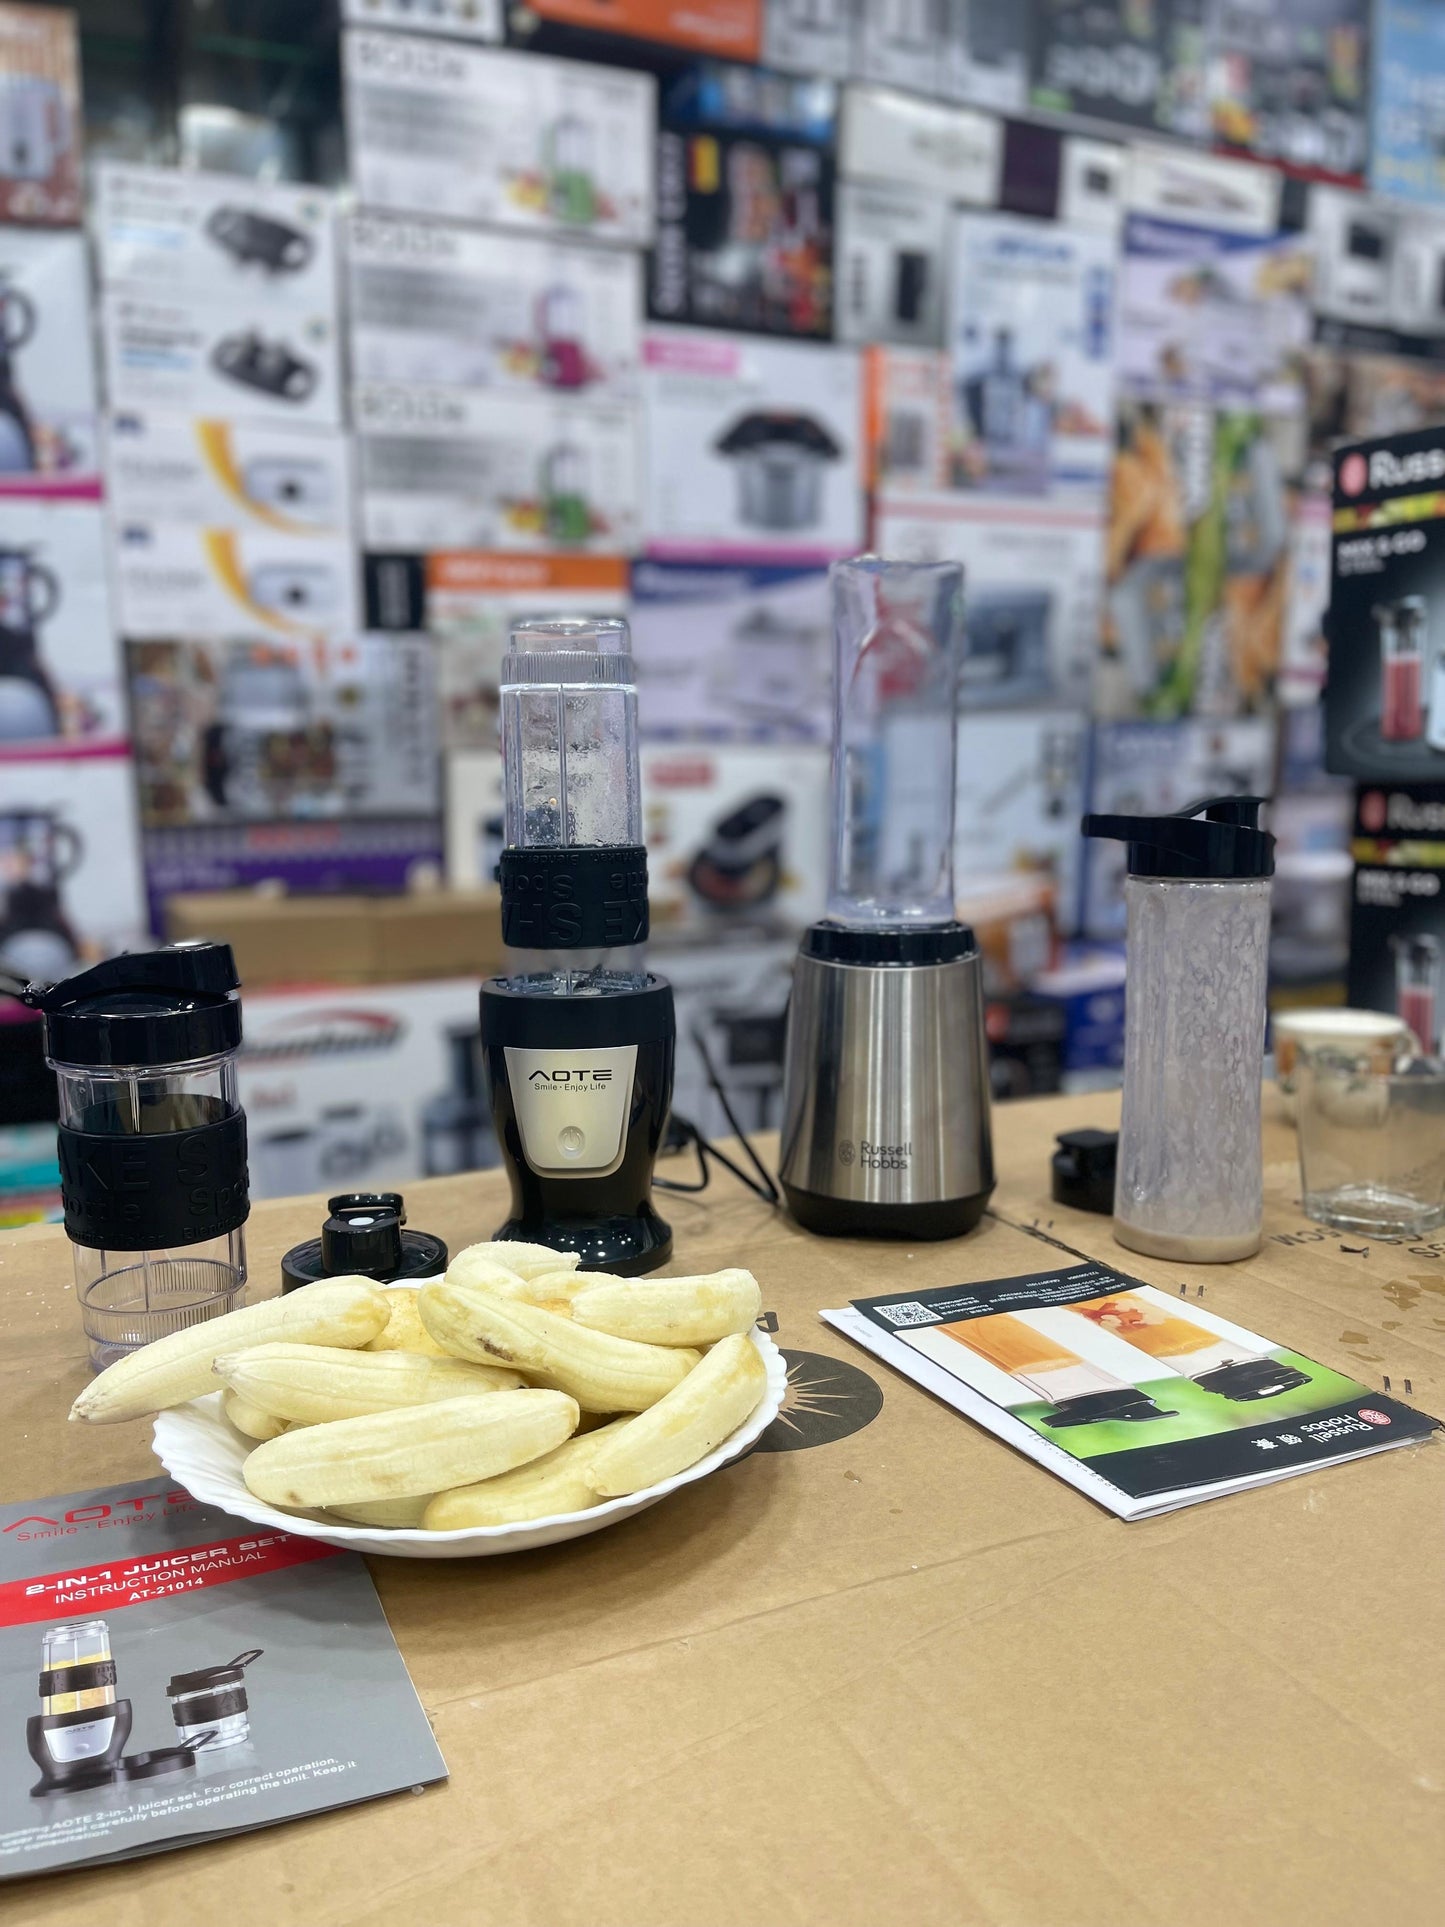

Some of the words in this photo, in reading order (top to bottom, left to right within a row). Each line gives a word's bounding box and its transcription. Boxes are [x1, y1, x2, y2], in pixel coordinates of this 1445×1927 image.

[528, 1069, 613, 1082] AOTE
[534, 1082, 558, 1091] Smile
[564, 1083, 588, 1093] Enjoy
[590, 1082, 606, 1091] Life
[861, 1140, 913, 1156] Russell
[861, 1155, 908, 1169] Hobbs
[1300, 1414, 1359, 1433] Hobbs
[1307, 1421, 1374, 1444] Russell
[17, 1525, 78, 1542] Smile
[97, 1510, 156, 1530] Enjoy
[26, 1570, 111, 1596] 2-IN-1
[124, 1547, 228, 1575] JUICER
[239, 1533, 292, 1551] SET
[56, 1568, 185, 1604] INSTRUCTION
[191, 1551, 267, 1574] MANUAL
[129, 1577, 204, 1601] AT-21014
[36, 1825, 87, 1841] manual
[90, 1812, 149, 1831] carefully
[151, 1800, 193, 1818] before
[197, 1786, 257, 1807] operating
[260, 1779, 280, 1790] the
[283, 1774, 310, 1785] unit.
[313, 1764, 345, 1778] Keep
[348, 1759, 358, 1769] it
[52, 1815, 93, 1831] AOTE
[96, 1806, 133, 1821] 2-in-1
[137, 1797, 174, 1814] juicer
[204, 1785, 227, 1796] For
[229, 1772, 274, 1790] correct
[276, 1757, 339, 1779] operation.
